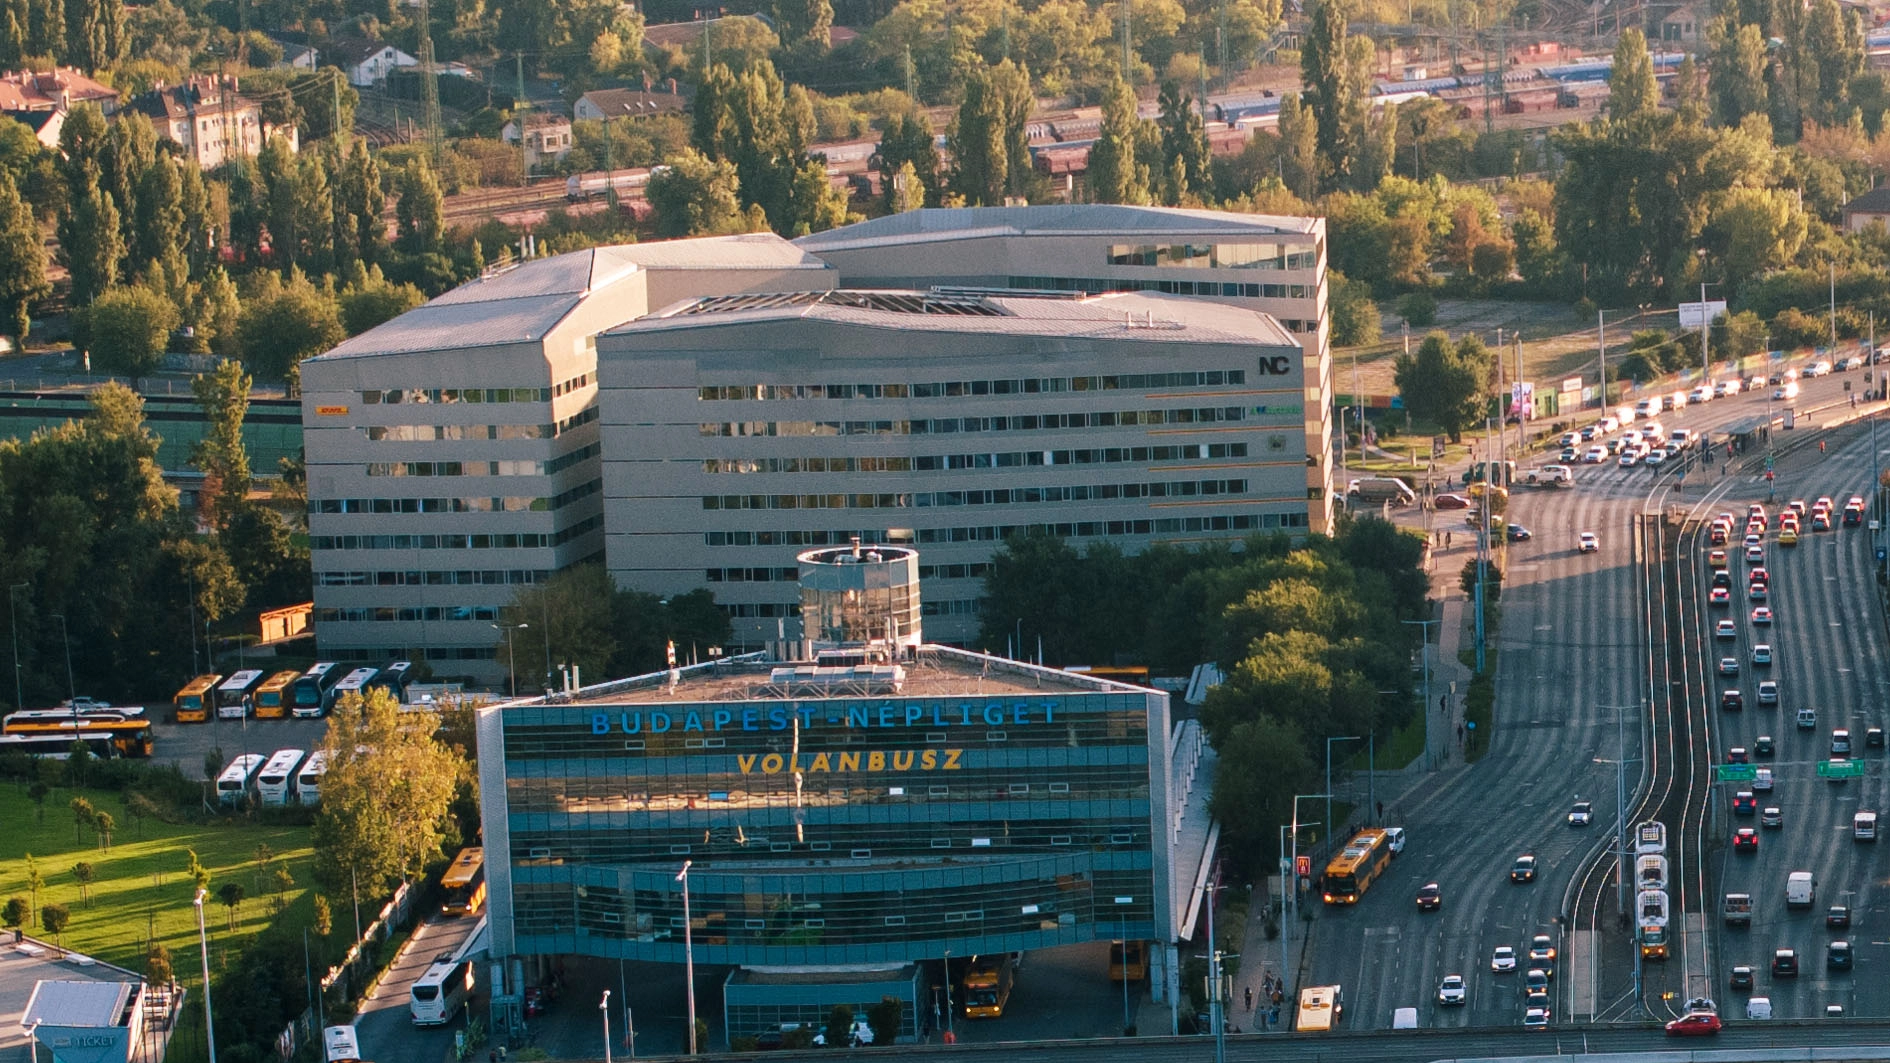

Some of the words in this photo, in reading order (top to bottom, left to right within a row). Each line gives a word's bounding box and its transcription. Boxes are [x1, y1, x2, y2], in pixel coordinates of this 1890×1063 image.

[1259, 356, 1290, 375] NC
[591, 701, 1059, 735] BUDAPEST-NÉPLIGET
[75, 1036, 114, 1047] TICKET
